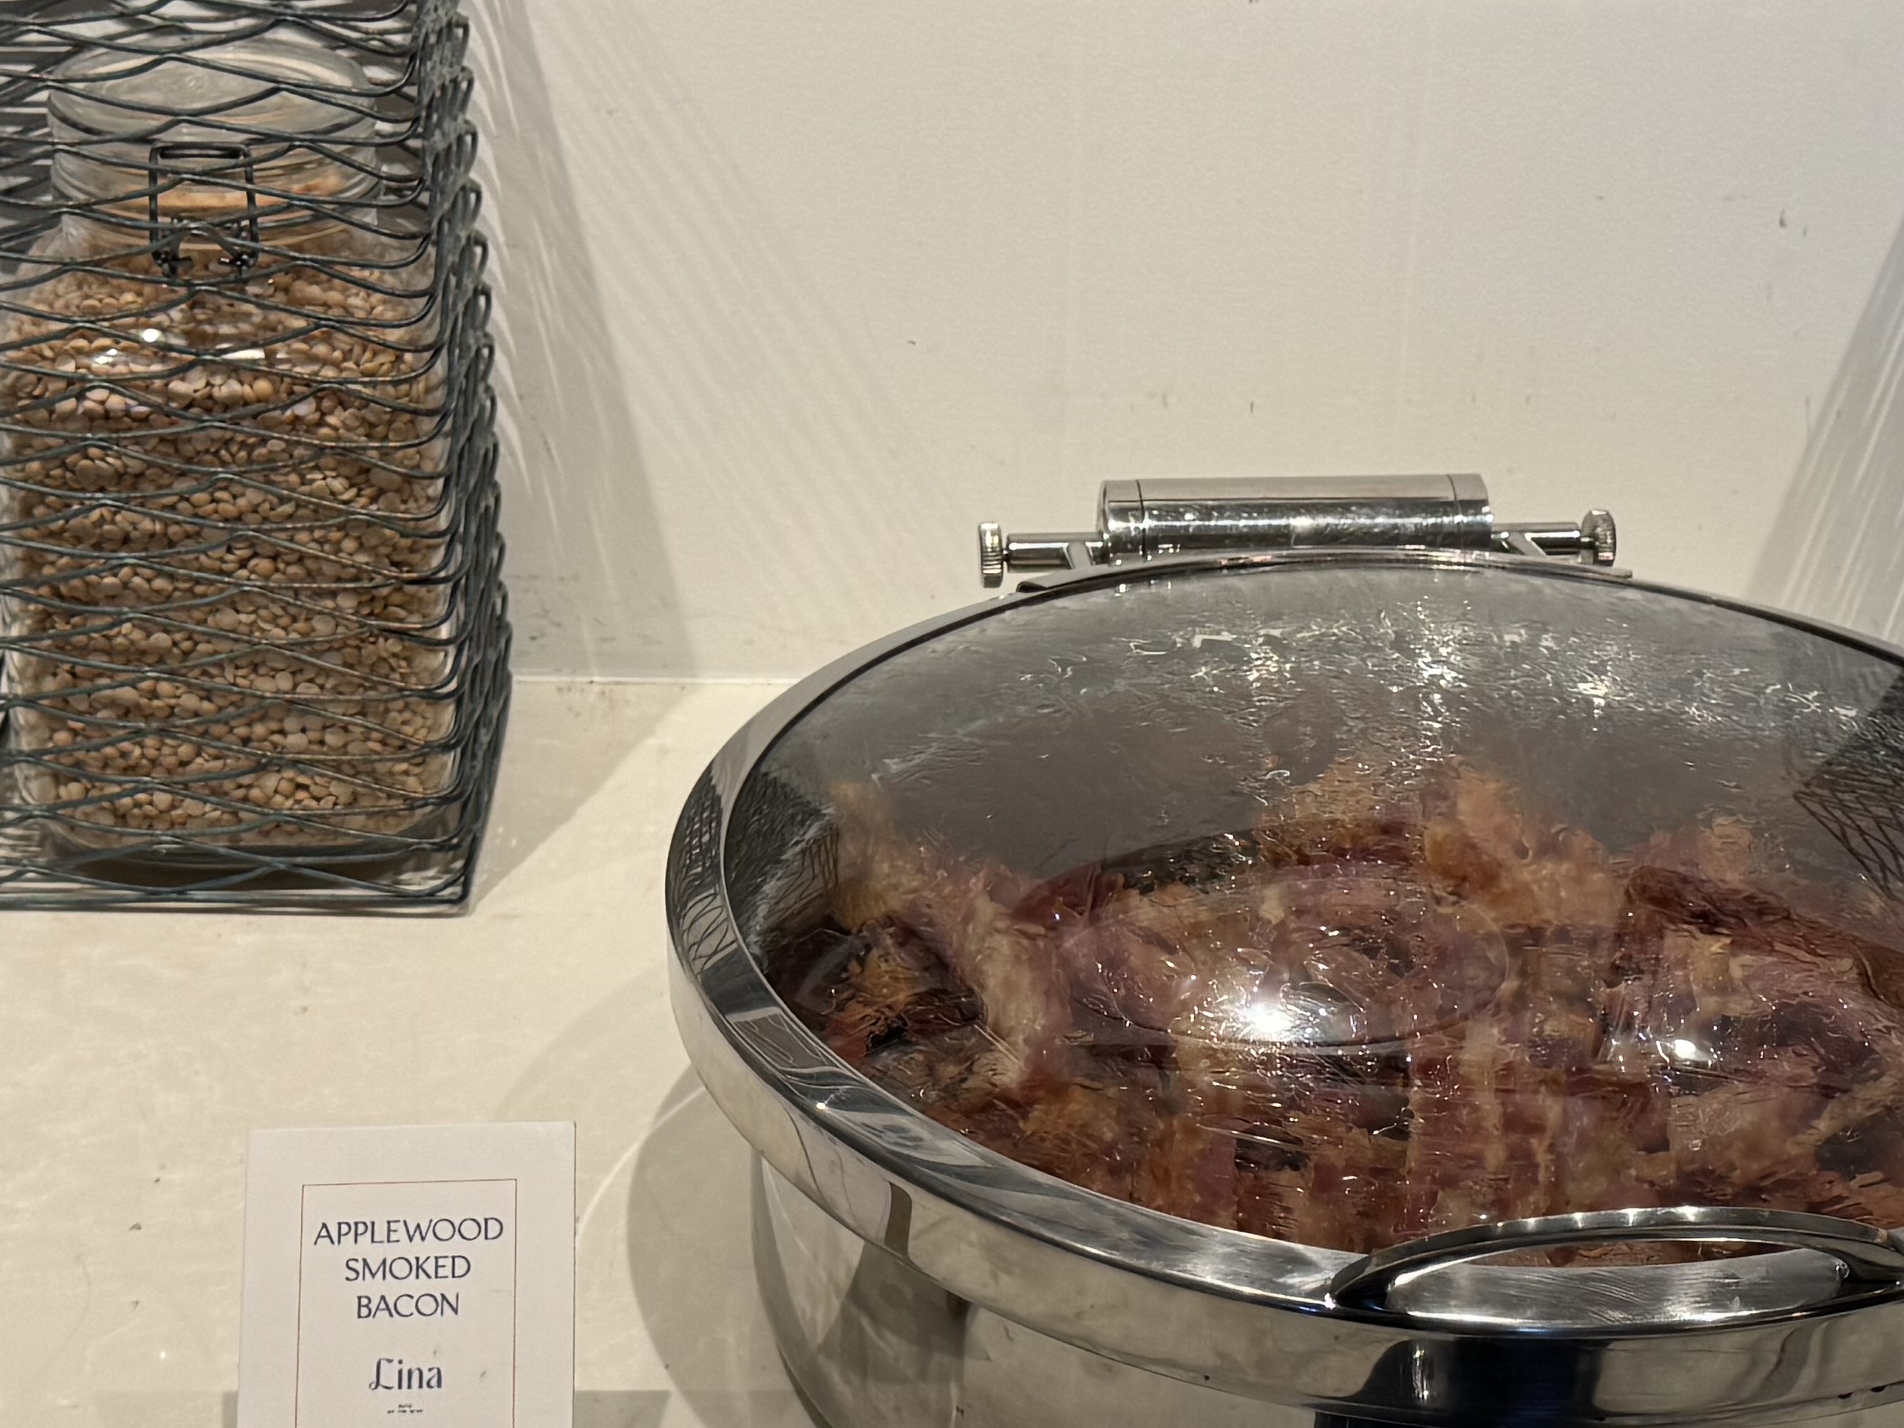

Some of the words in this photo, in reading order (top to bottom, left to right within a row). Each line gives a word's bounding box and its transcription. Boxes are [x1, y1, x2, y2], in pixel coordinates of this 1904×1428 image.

[313, 1217, 504, 1246] APPLEWOOD
[344, 1255, 472, 1282] SMOKED
[356, 1292, 460, 1319] BACON
[369, 1357, 443, 1391] Lina
